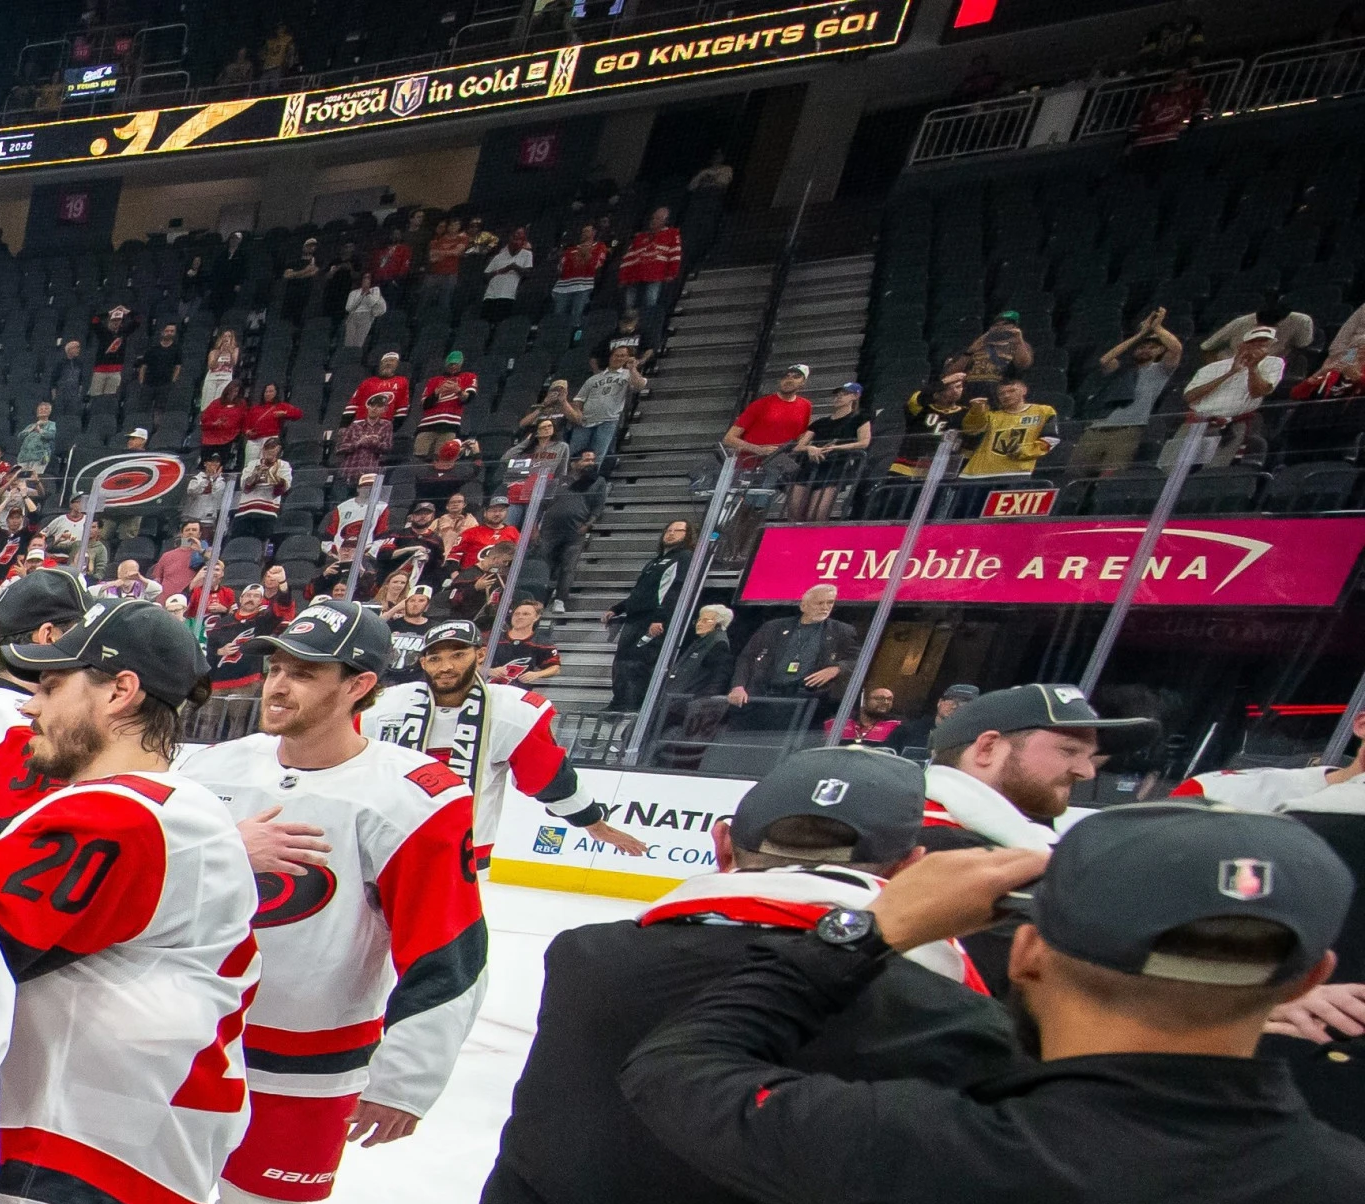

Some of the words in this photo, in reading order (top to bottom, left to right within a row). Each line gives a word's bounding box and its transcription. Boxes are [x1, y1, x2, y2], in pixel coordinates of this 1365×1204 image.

[595, 50, 640, 74] GO
[648, 24, 806, 67] KNIGHTS
[814, 11, 879, 40] GO!
[305, 88, 388, 124] Forged
[427, 80, 453, 104] in
[459, 65, 520, 98] Gold
[9, 141, 32, 152] 2026
[993, 491, 1047, 515] EXIT
[1018, 556, 1207, 580] ARENA
[535, 845, 561, 855] RBC
[2, 831, 121, 915] 20
